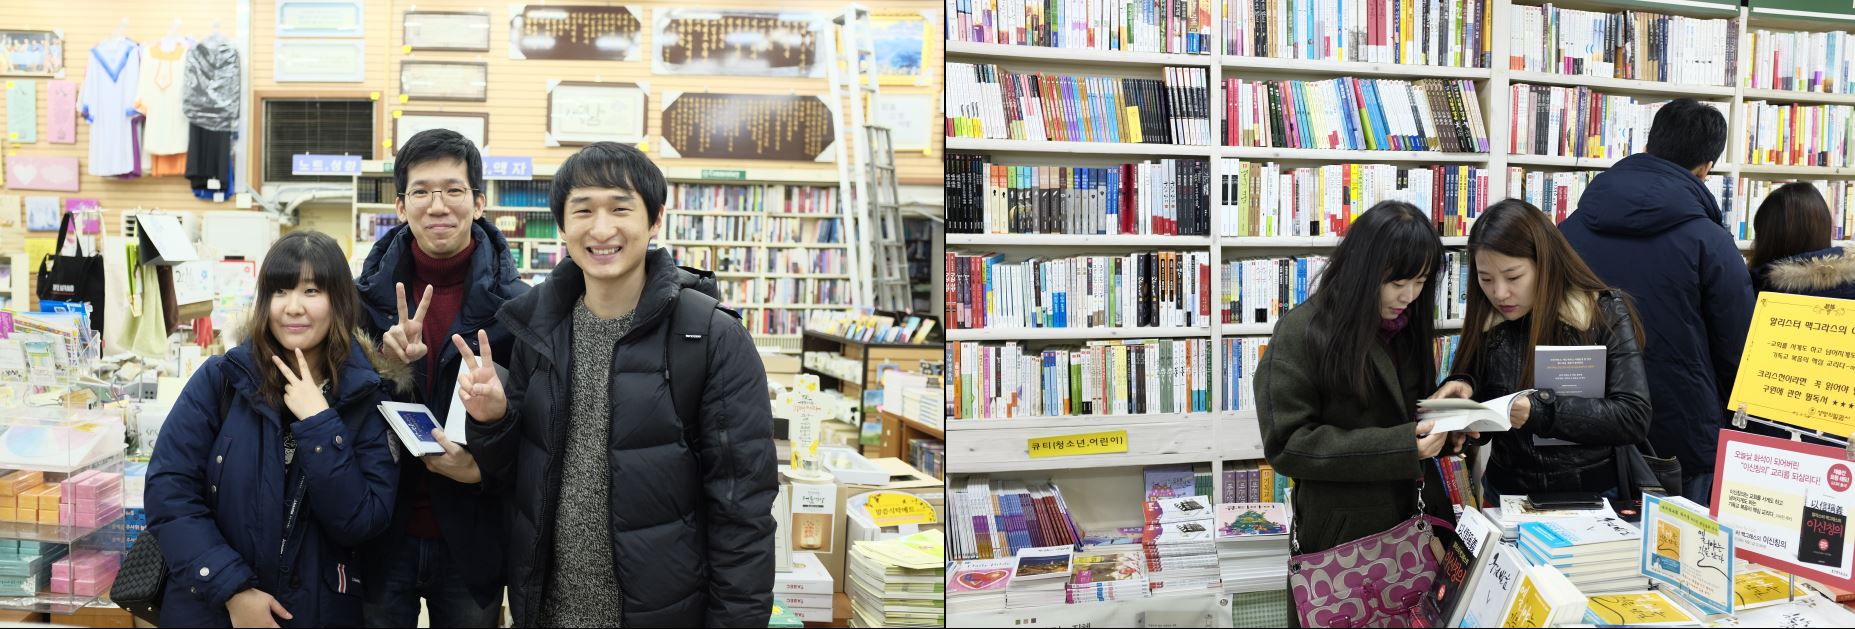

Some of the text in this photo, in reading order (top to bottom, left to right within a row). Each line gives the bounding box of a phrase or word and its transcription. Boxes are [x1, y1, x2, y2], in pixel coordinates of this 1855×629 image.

[1769, 317, 1801, 329] 알리스터
[1763, 385, 1784, 396] 구원에
[1787, 389, 1802, 400] 관한
[1825, 381, 1849, 394] 읽어야
[1734, 450, 1800, 470] 오늘날 화석이 되어버린
[1771, 469, 1790, 480] 교리를
